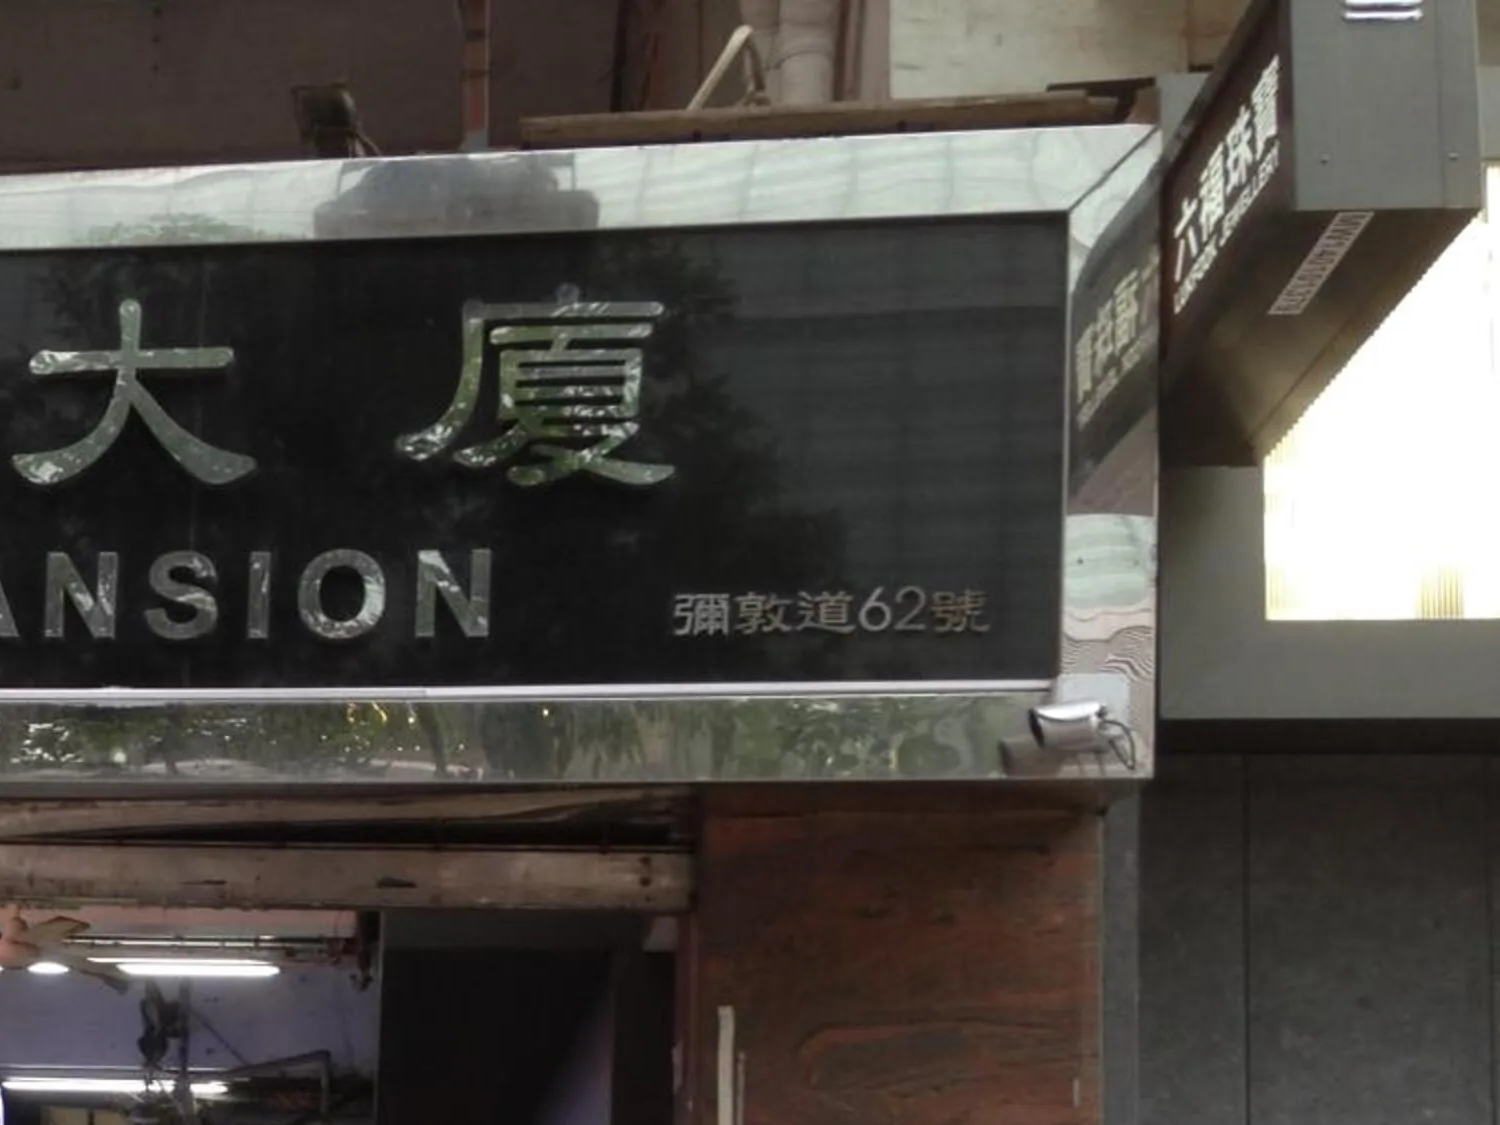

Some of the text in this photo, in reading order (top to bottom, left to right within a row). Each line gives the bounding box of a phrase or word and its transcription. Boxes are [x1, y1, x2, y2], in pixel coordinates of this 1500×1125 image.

[1173, 54, 1280, 283] 六福珠寶
[671, 585, 992, 637] 彌敦道62號
